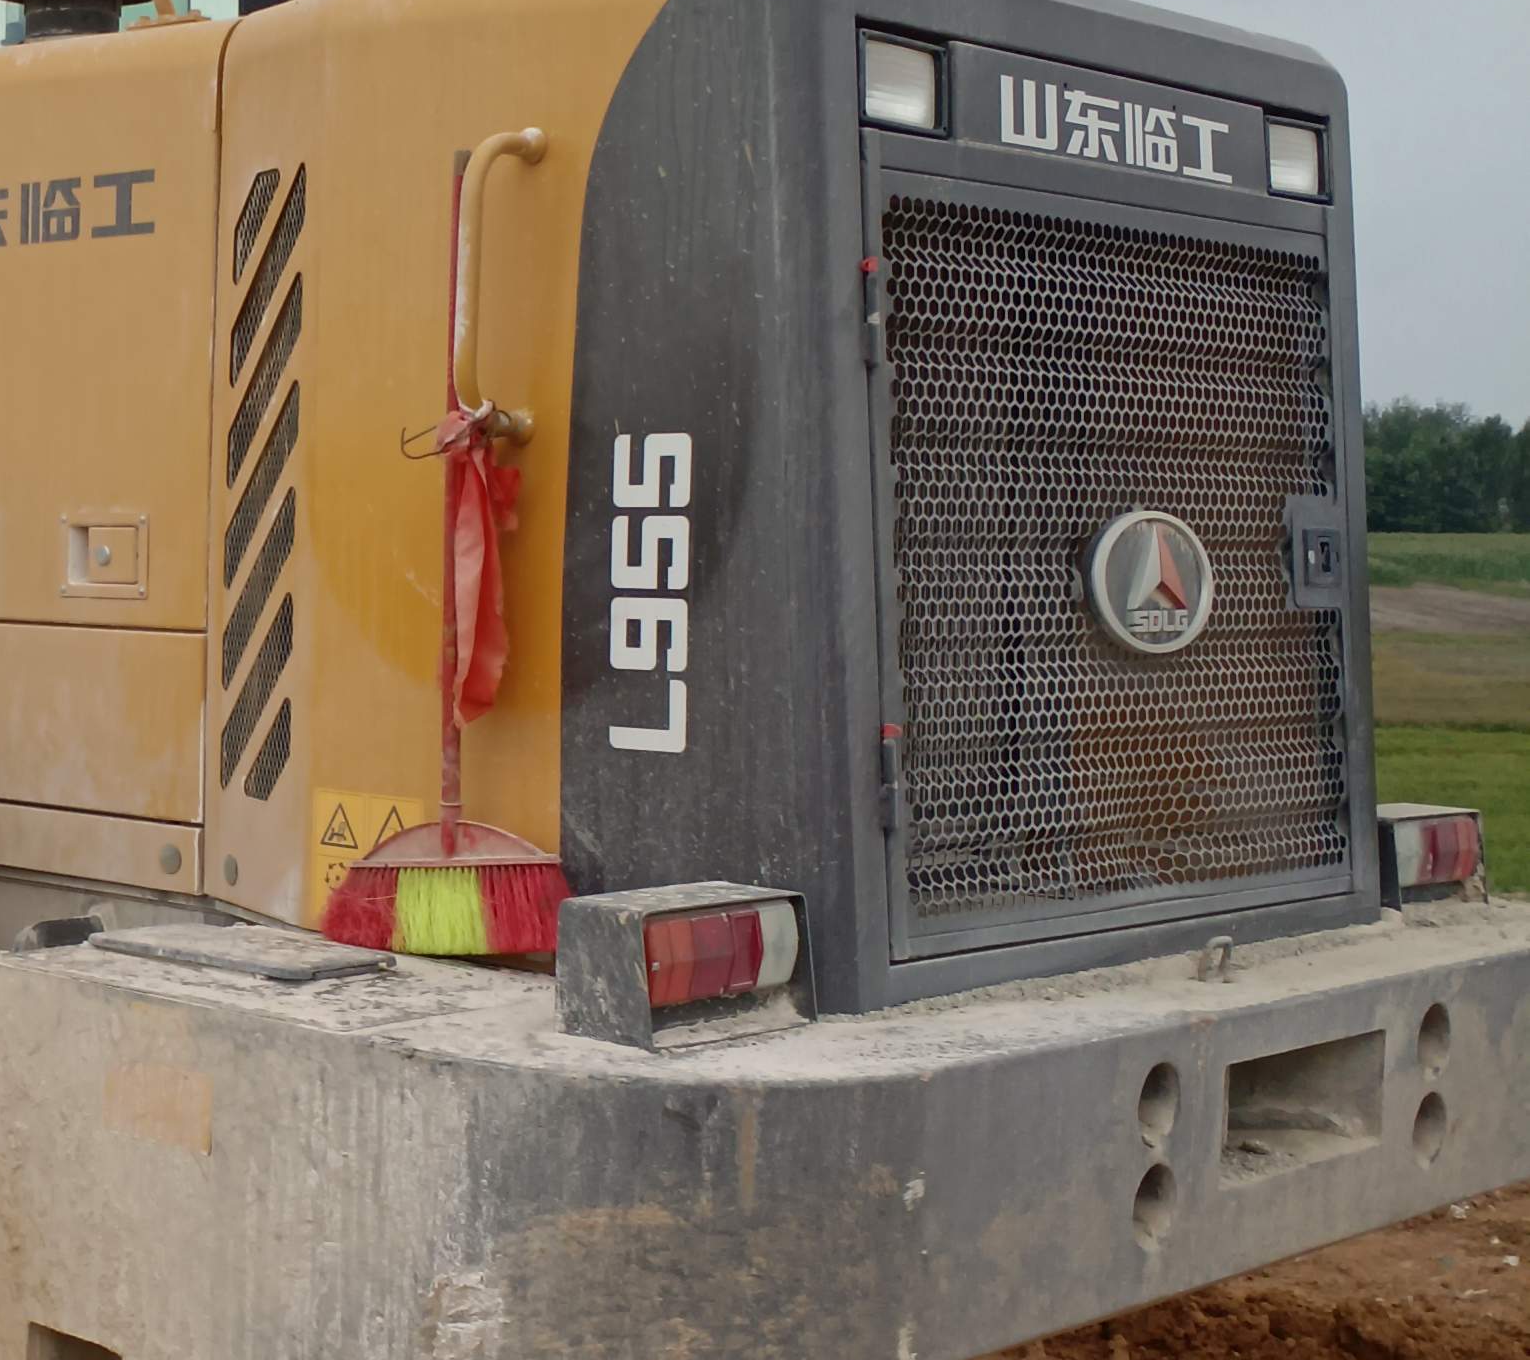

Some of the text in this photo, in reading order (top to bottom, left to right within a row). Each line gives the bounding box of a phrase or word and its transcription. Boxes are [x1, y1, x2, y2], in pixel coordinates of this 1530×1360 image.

[999, 74, 1234, 185] 山东临工
[608, 432, 693, 754] L955
[1126, 609, 1189, 633] SDLG
